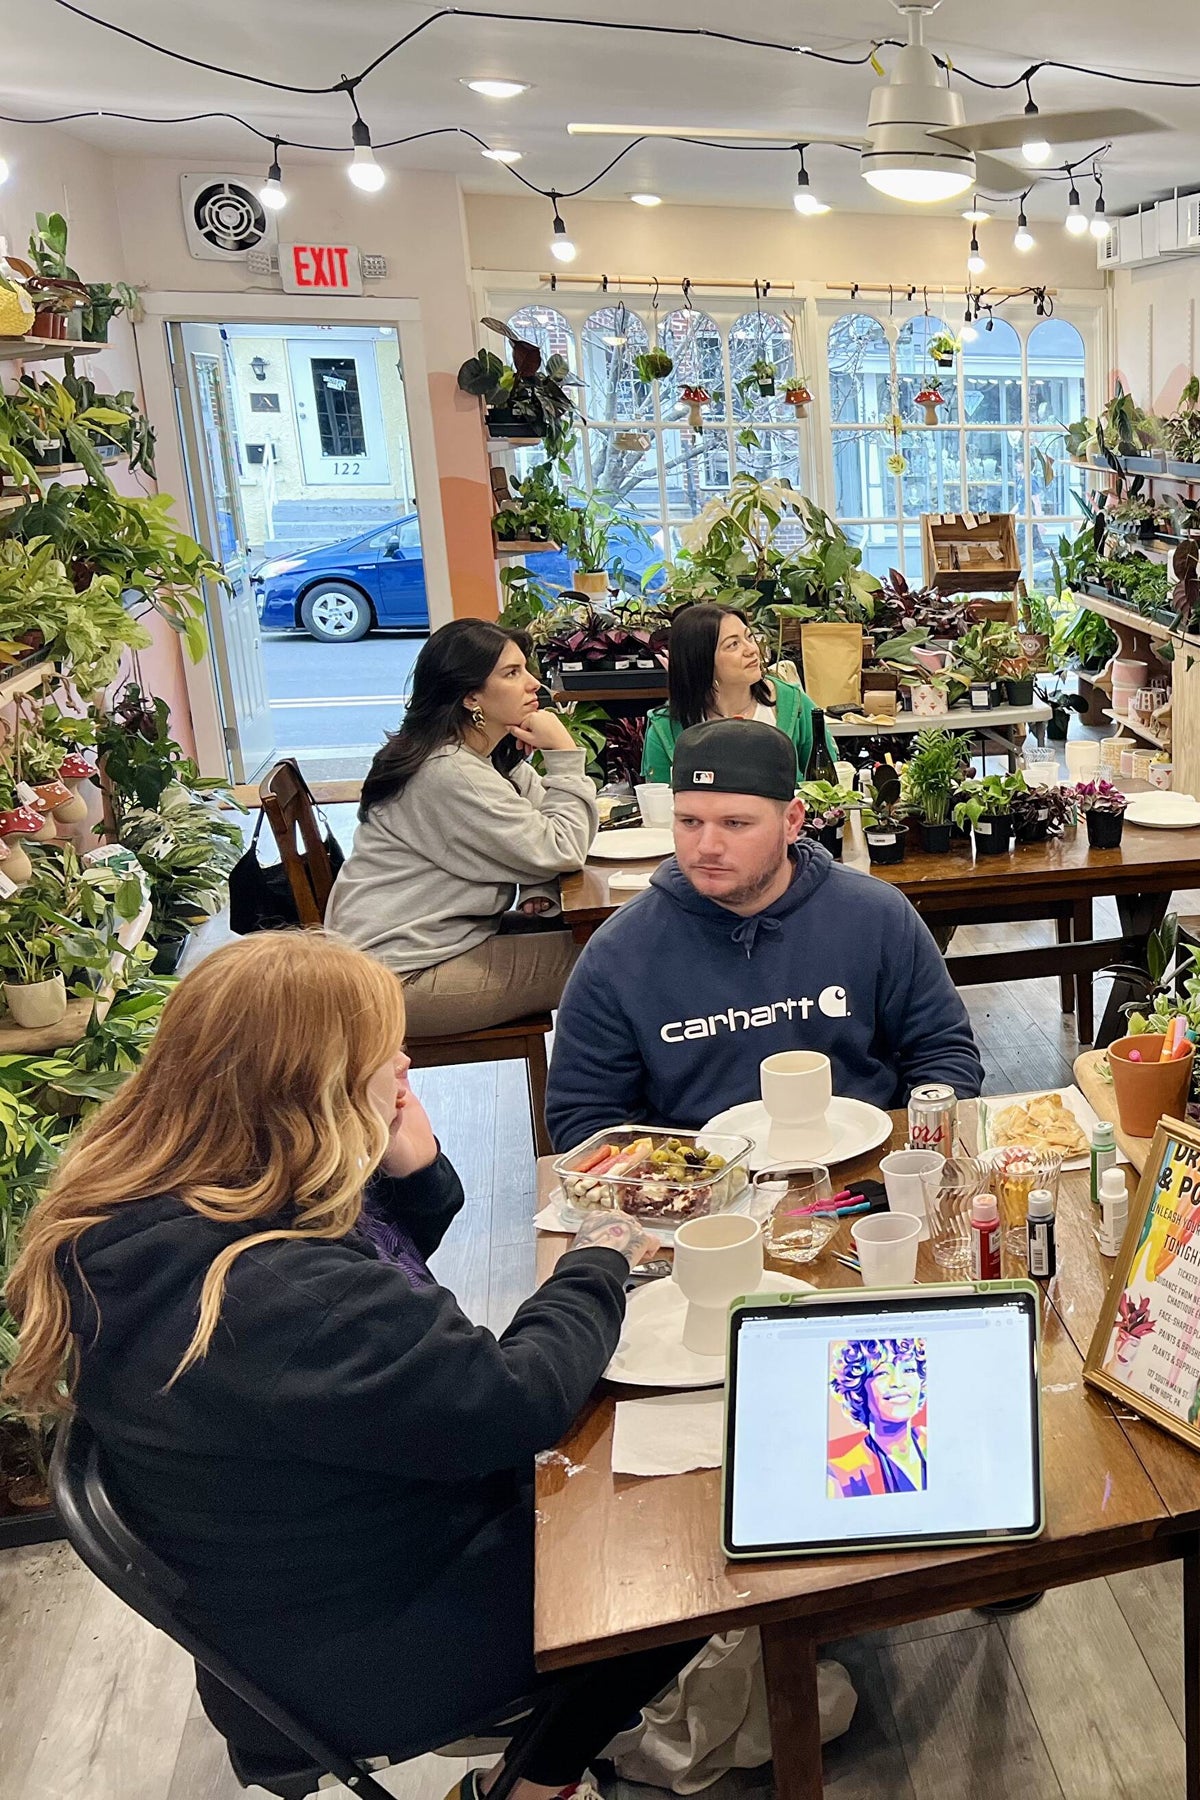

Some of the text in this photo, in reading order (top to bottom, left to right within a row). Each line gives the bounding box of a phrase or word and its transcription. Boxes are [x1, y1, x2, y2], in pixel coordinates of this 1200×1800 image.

[292, 246, 349, 288] EXIT
[333, 462, 361, 476] 122
[660, 997, 814, 1043] carhartt
[912, 1125, 945, 1143] ors
[1158, 1166, 1173, 1192] &
[1150, 1200, 1182, 1225] UNLEASH
[1182, 1215, 1200, 1234] YOUR
[1154, 1276, 1178, 1294] GUIDANCE
[1178, 1286, 1193, 1300] FROM
[1177, 1267, 1198, 1285] TICKETS
[1167, 1294, 1194, 1318] CHAOTIQUE
[1158, 1309, 1193, 1335] FACE-SHAPED
[1158, 1328, 1176, 1345] PAINTS
[1176, 1338, 1181, 1348] &
[1151, 1344, 1200, 1378] PLANTS & SUPPLIES
[1149, 1382, 1160, 1395] NEW
[1173, 1398, 1181, 1407] PA
[1155, 1373, 1170, 1387] SOUTH
[1169, 1382, 1182, 1395] MAIN
